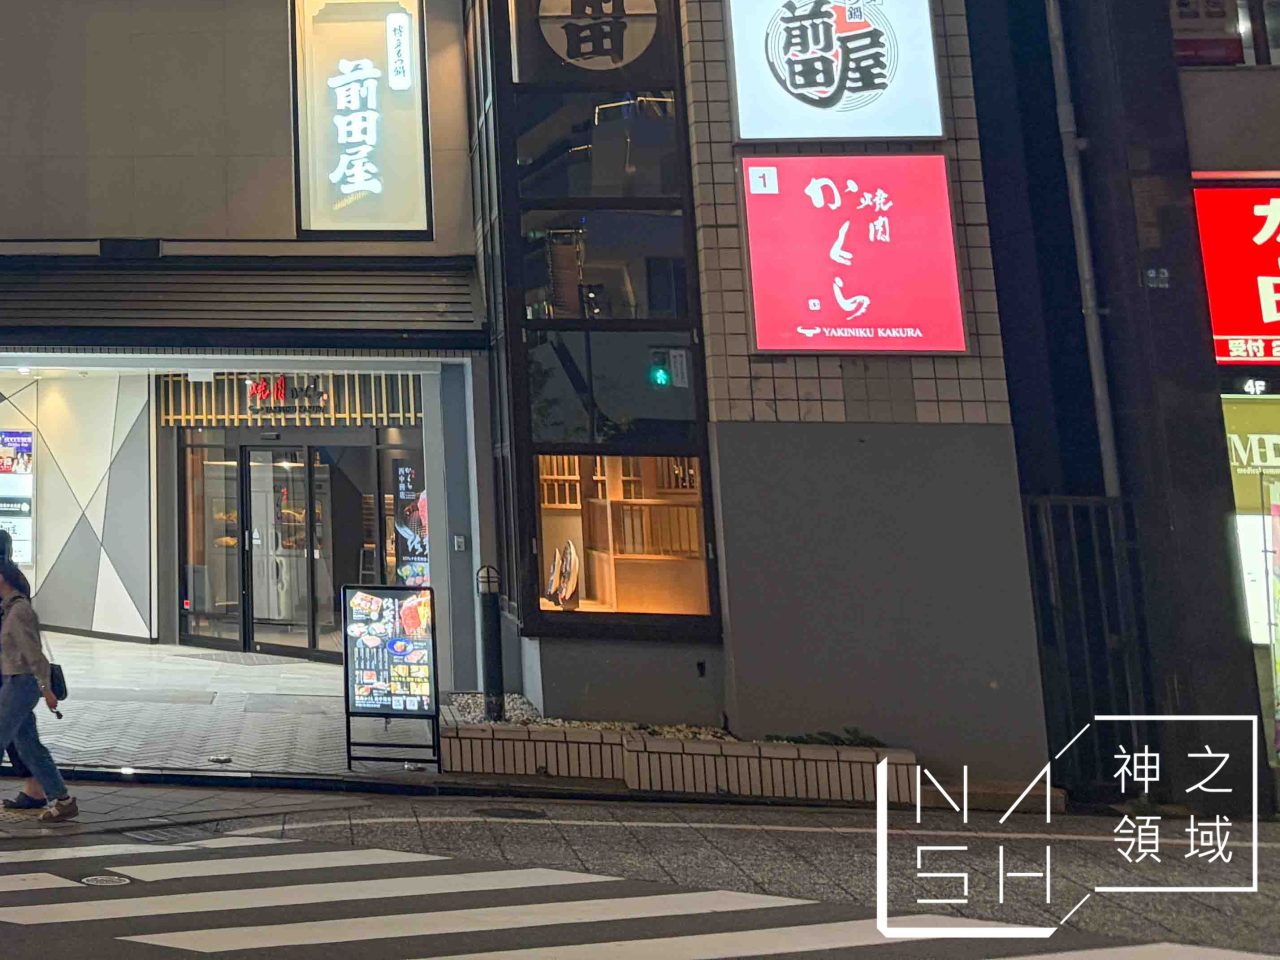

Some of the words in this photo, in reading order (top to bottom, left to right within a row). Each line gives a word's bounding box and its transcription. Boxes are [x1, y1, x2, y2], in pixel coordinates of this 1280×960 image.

[328, 58, 383, 195] 前田屋
[758, 173, 767, 188] 1
[856, 188, 894, 243] 焼肉
[804, 177, 871, 321] かくら
[823, 327, 874, 338] YAKINIKU
[878, 327, 923, 338] KAKURA
[1228, 339, 1264, 358] 受付
[1244, 381, 1266, 395] 4F
